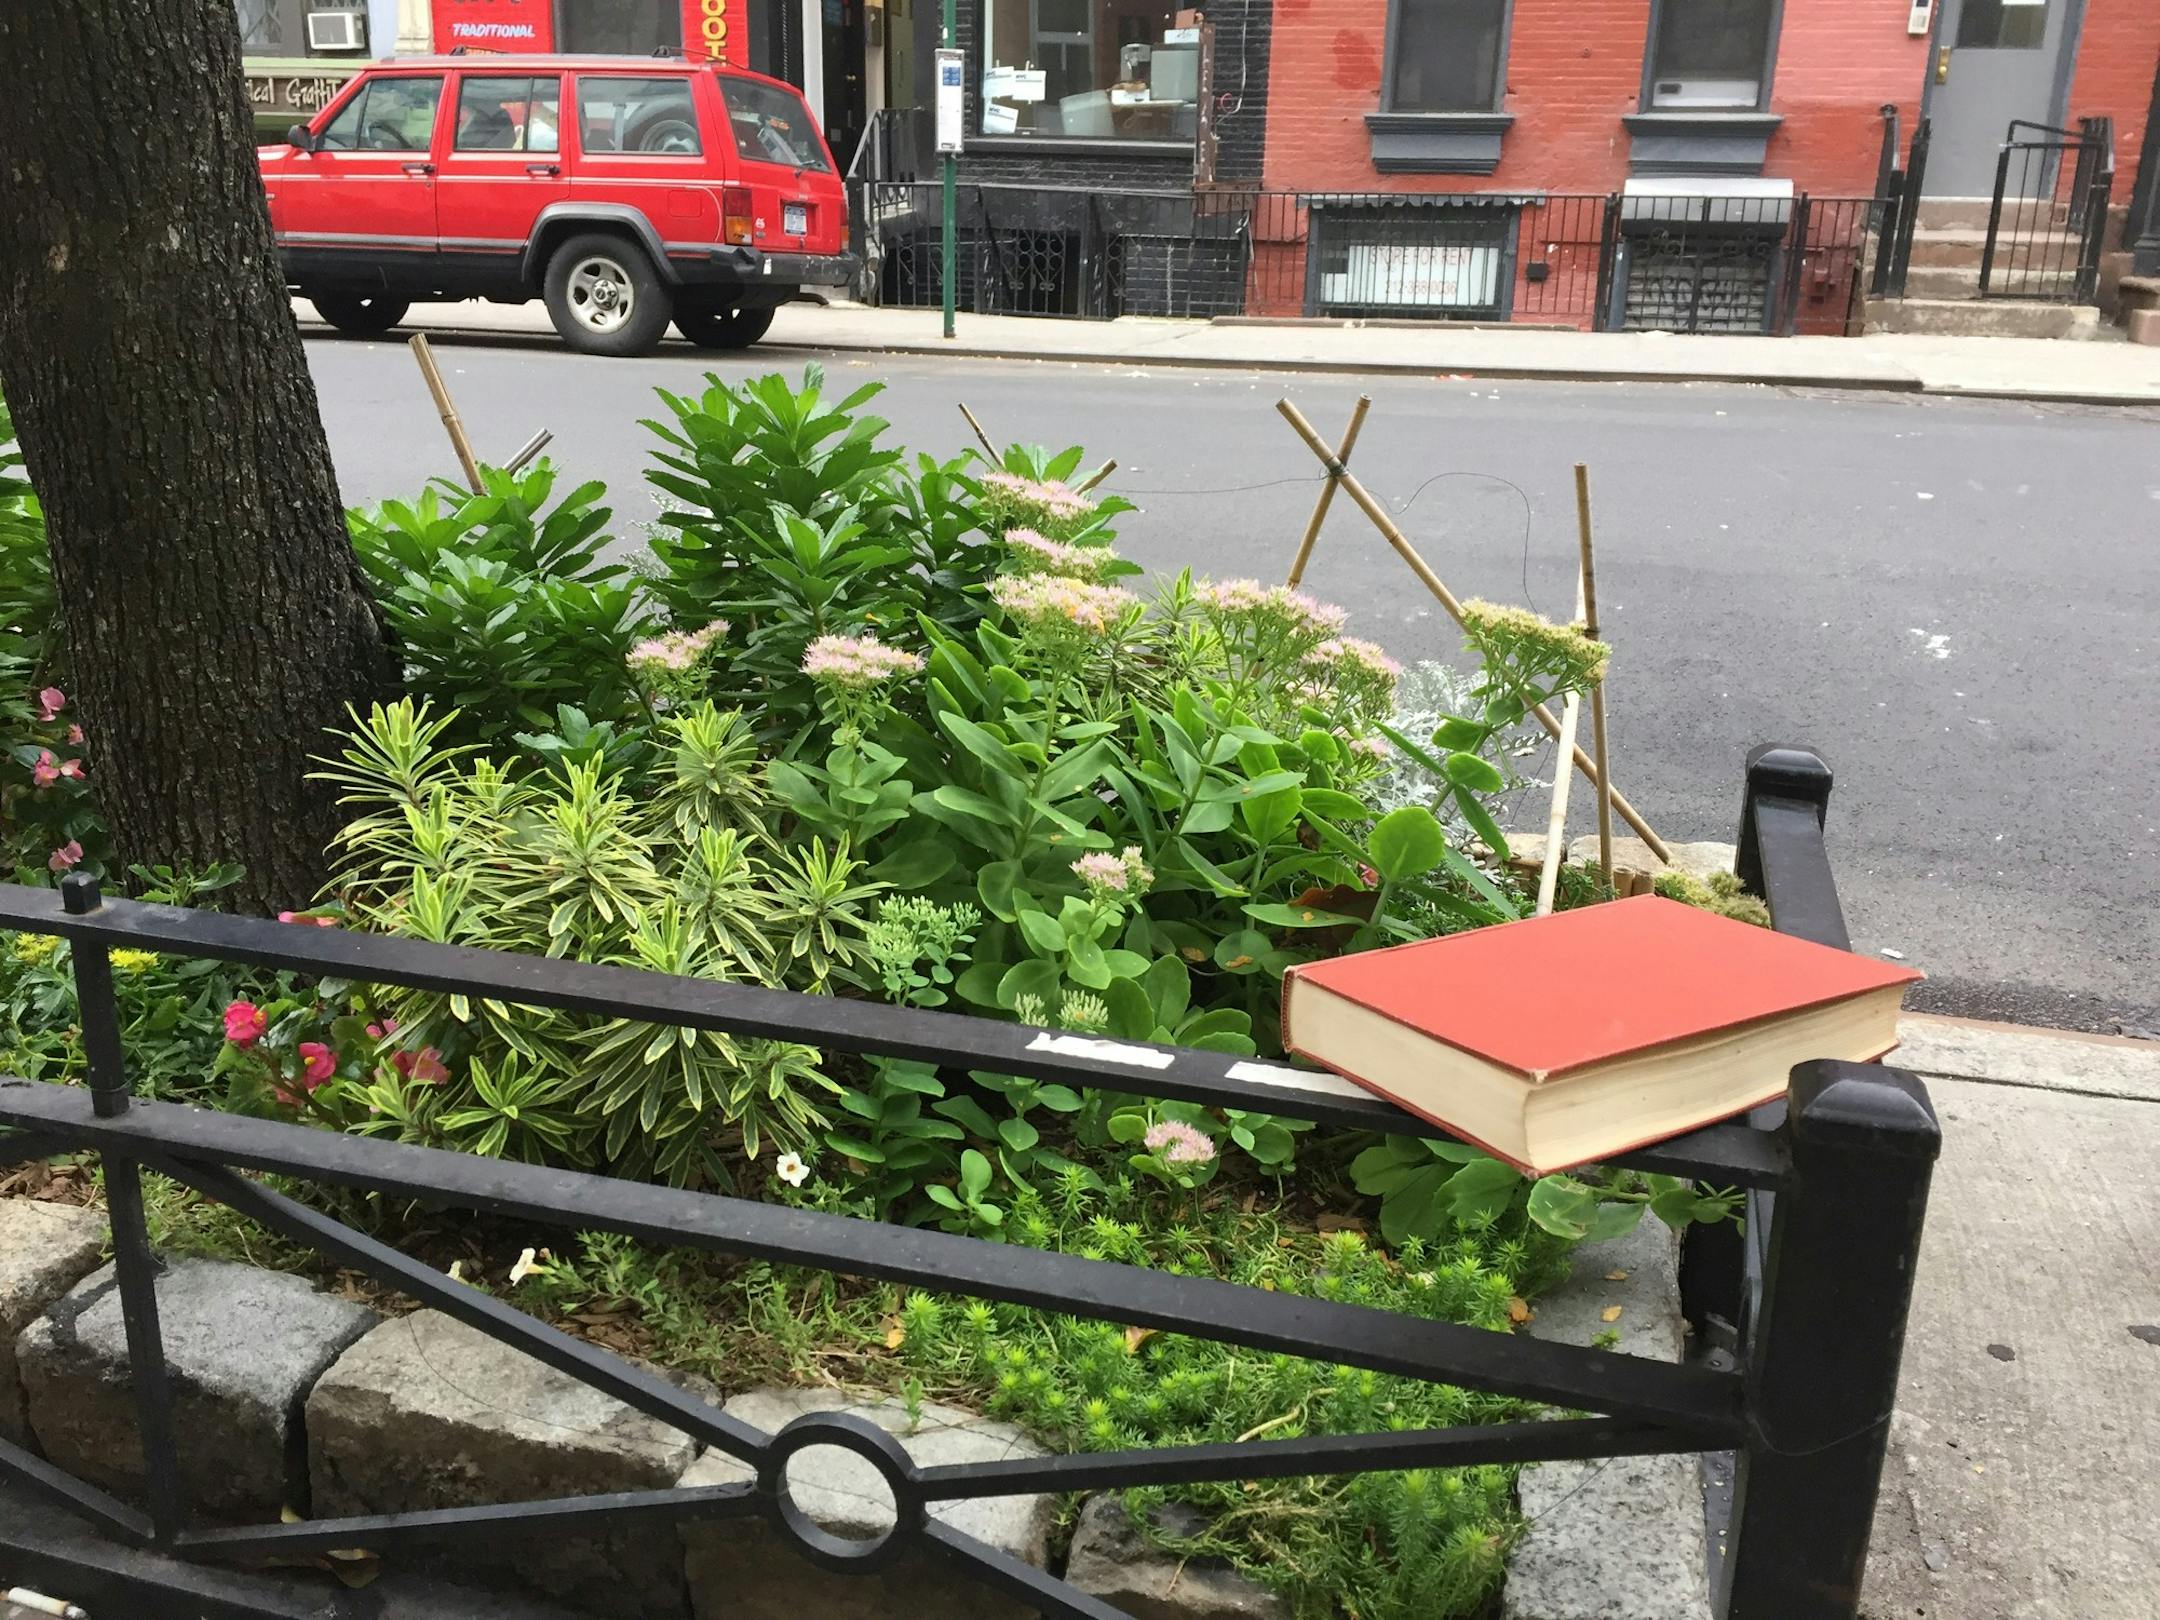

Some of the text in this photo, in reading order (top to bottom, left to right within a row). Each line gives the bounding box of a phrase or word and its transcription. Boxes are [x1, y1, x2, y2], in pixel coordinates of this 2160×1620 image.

[452, 23, 535, 38] TRADITIONAL
[1371, 247, 1474, 266] STORE FOR RENT
